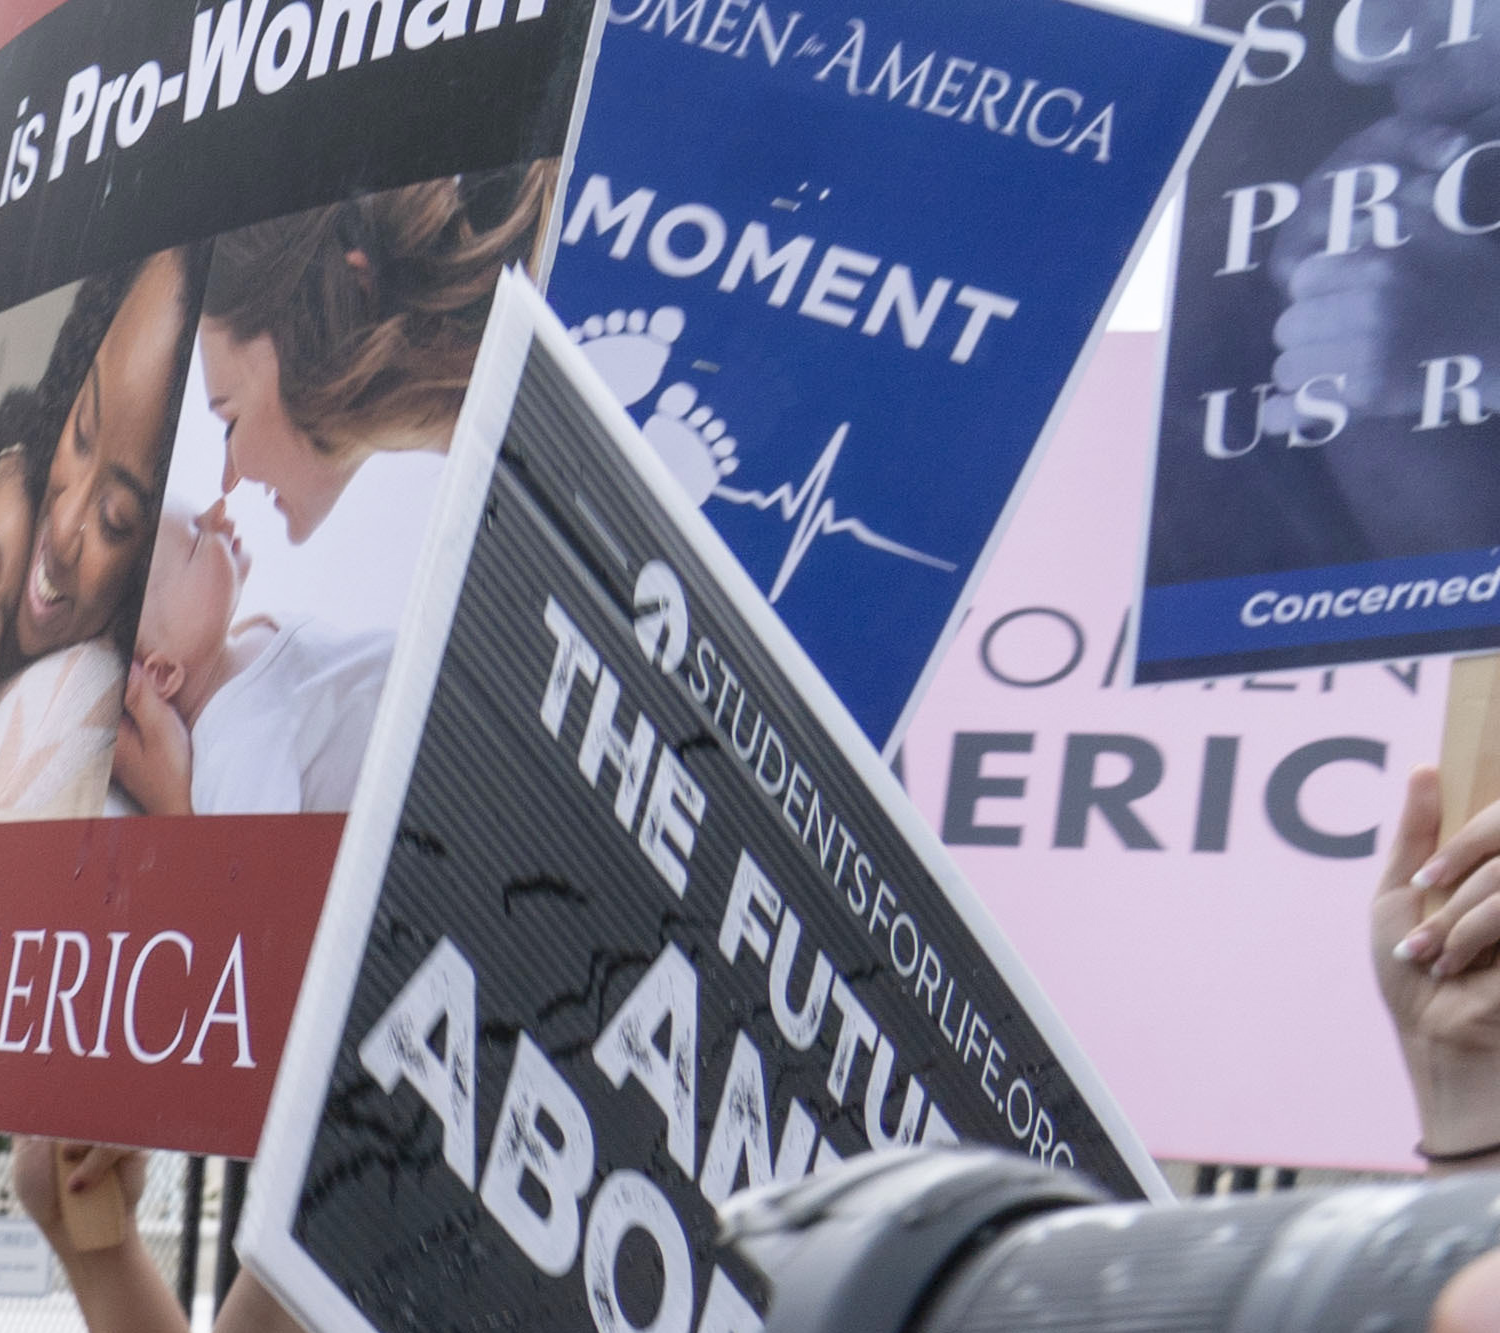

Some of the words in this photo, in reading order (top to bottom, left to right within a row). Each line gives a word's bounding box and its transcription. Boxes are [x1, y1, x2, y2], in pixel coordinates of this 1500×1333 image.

[812, 17, 1116, 163] AMERICA
[561, 172, 1020, 364] MOMENT
[1200, 373, 1349, 460] US
[538, 593, 707, 900] THE
